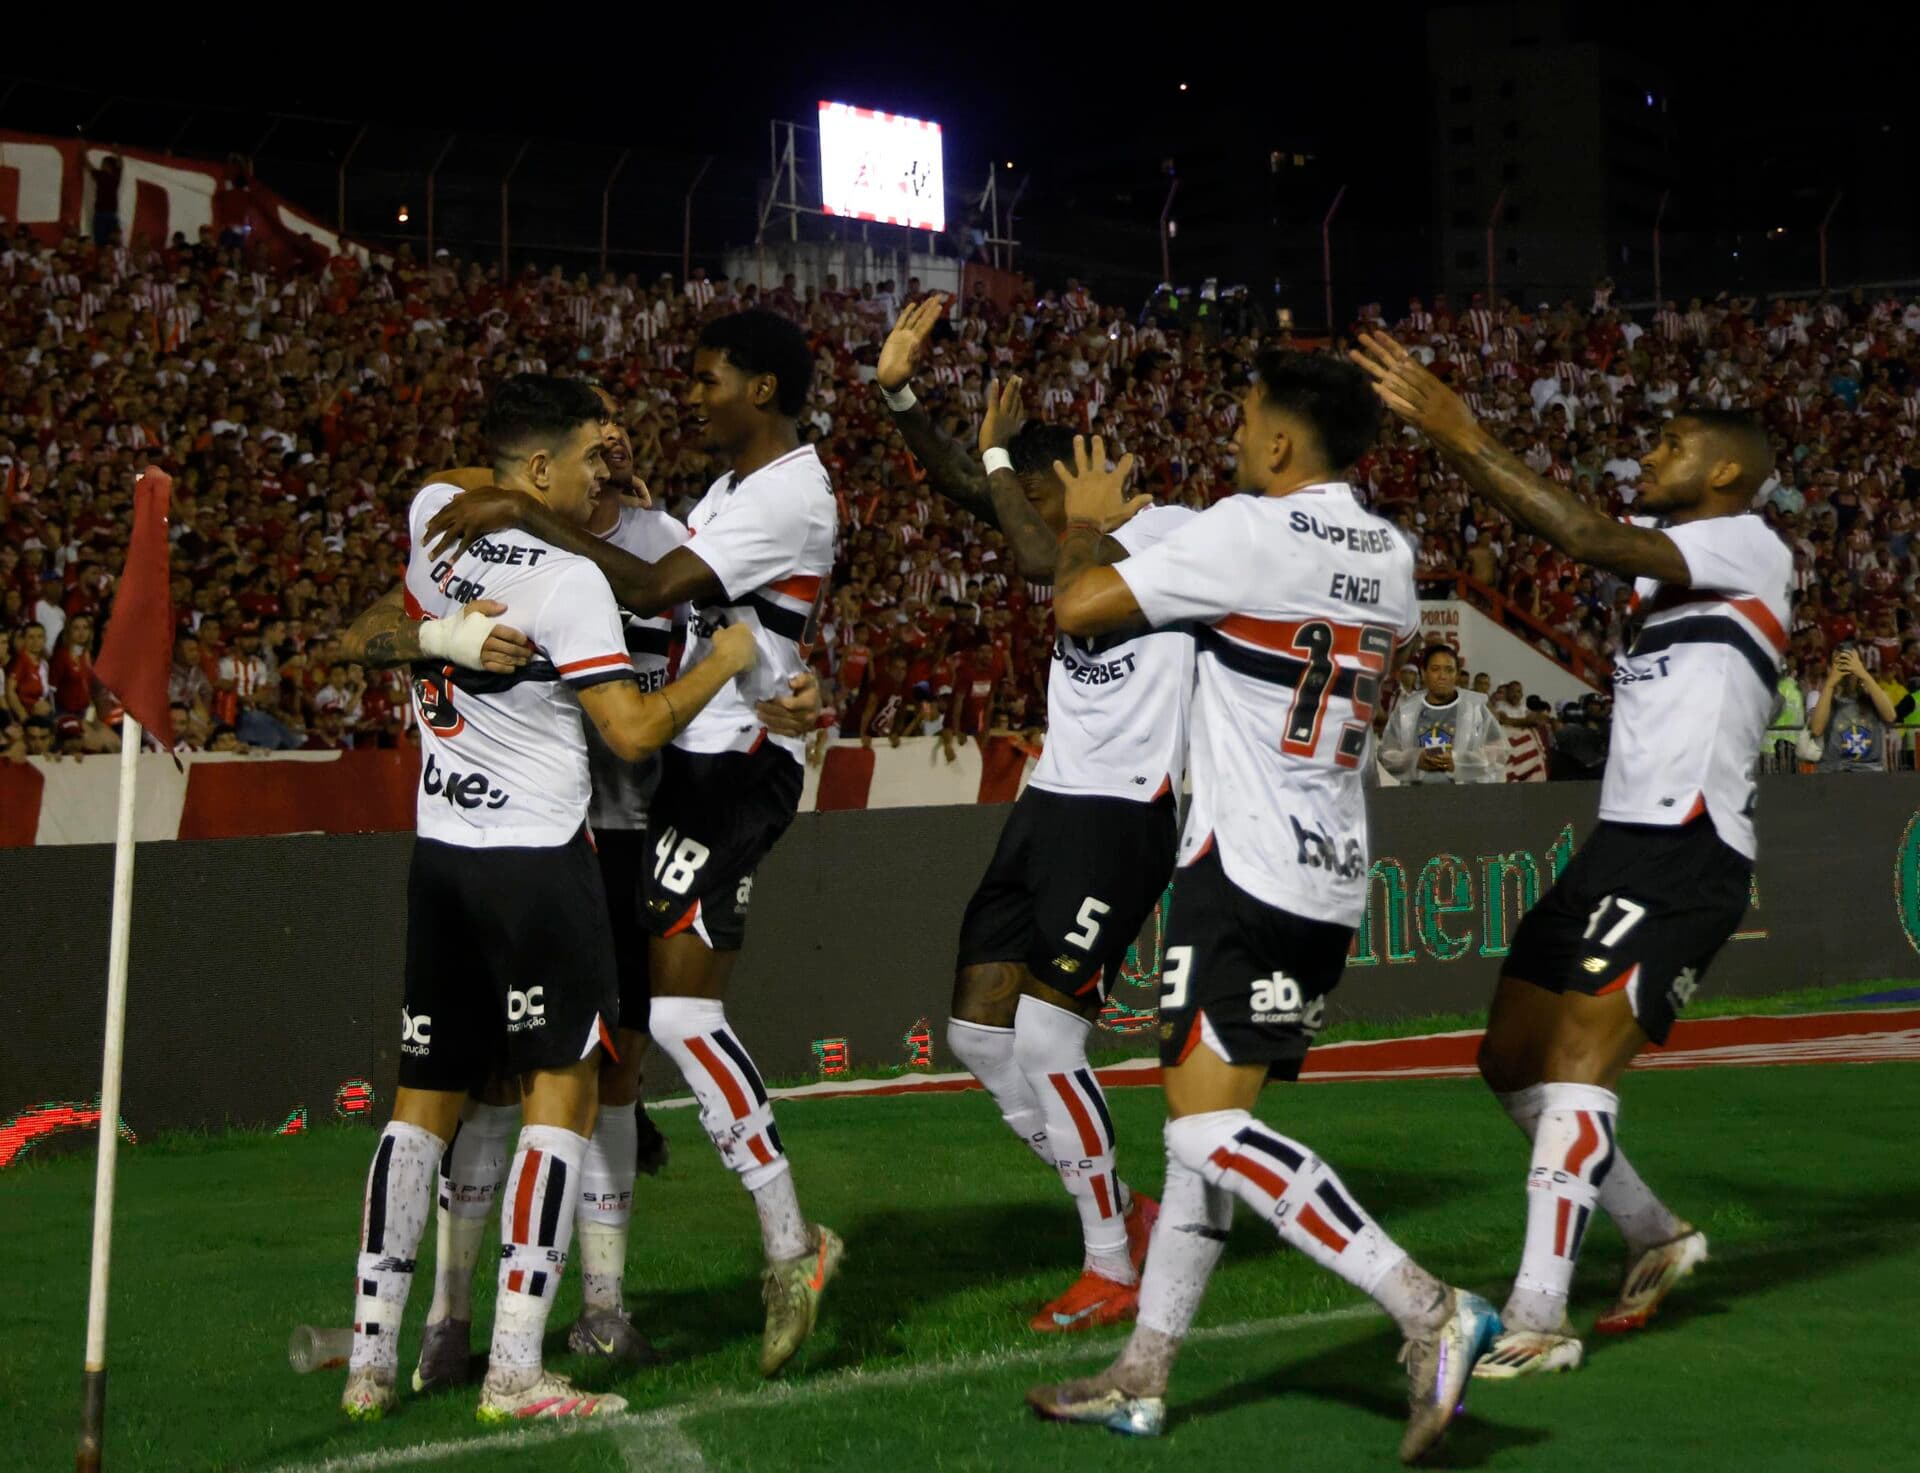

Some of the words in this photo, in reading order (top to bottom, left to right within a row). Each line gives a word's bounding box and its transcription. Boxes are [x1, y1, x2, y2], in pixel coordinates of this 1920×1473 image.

[468, 537, 547, 566] ERBET
[1329, 573, 1381, 604] ENZO
[654, 825, 710, 895] 48
[1064, 896, 1111, 950] 5
[1583, 895, 1646, 948] 17
[1160, 945, 1193, 1009] 3
